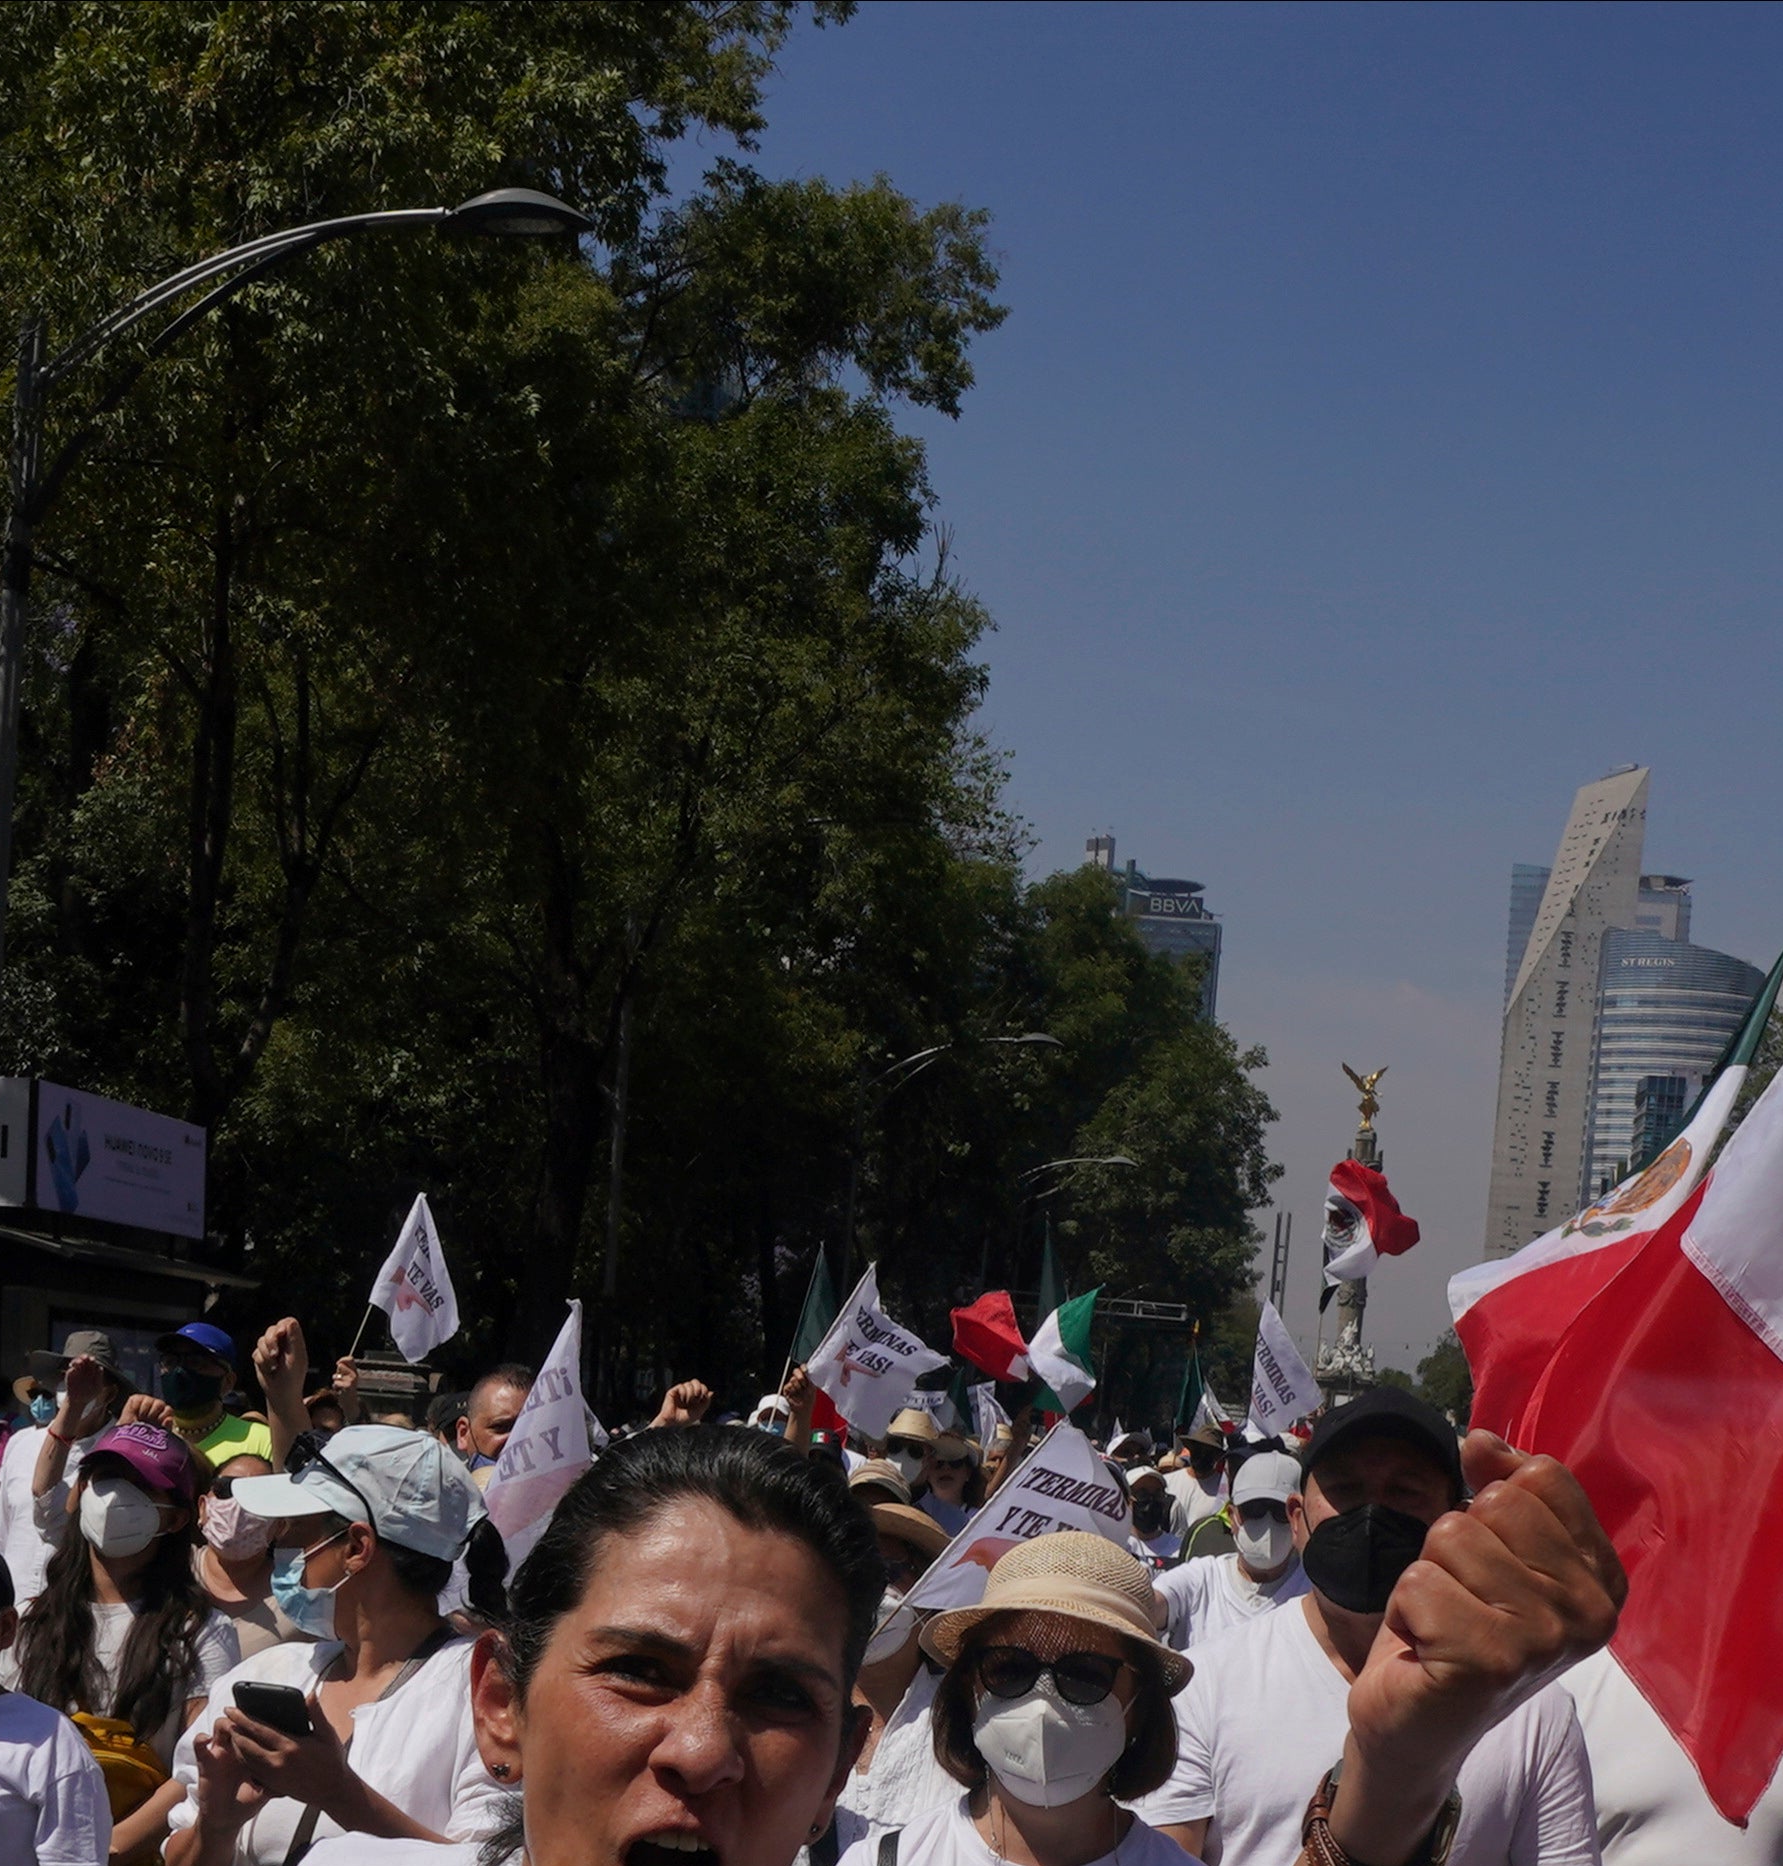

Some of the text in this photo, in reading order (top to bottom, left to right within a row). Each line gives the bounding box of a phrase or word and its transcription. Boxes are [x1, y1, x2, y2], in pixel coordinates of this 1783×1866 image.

[1149, 897, 1201, 914] BBVA
[995, 1505, 1017, 1532] Y
[1012, 1509, 1053, 1540] TE
